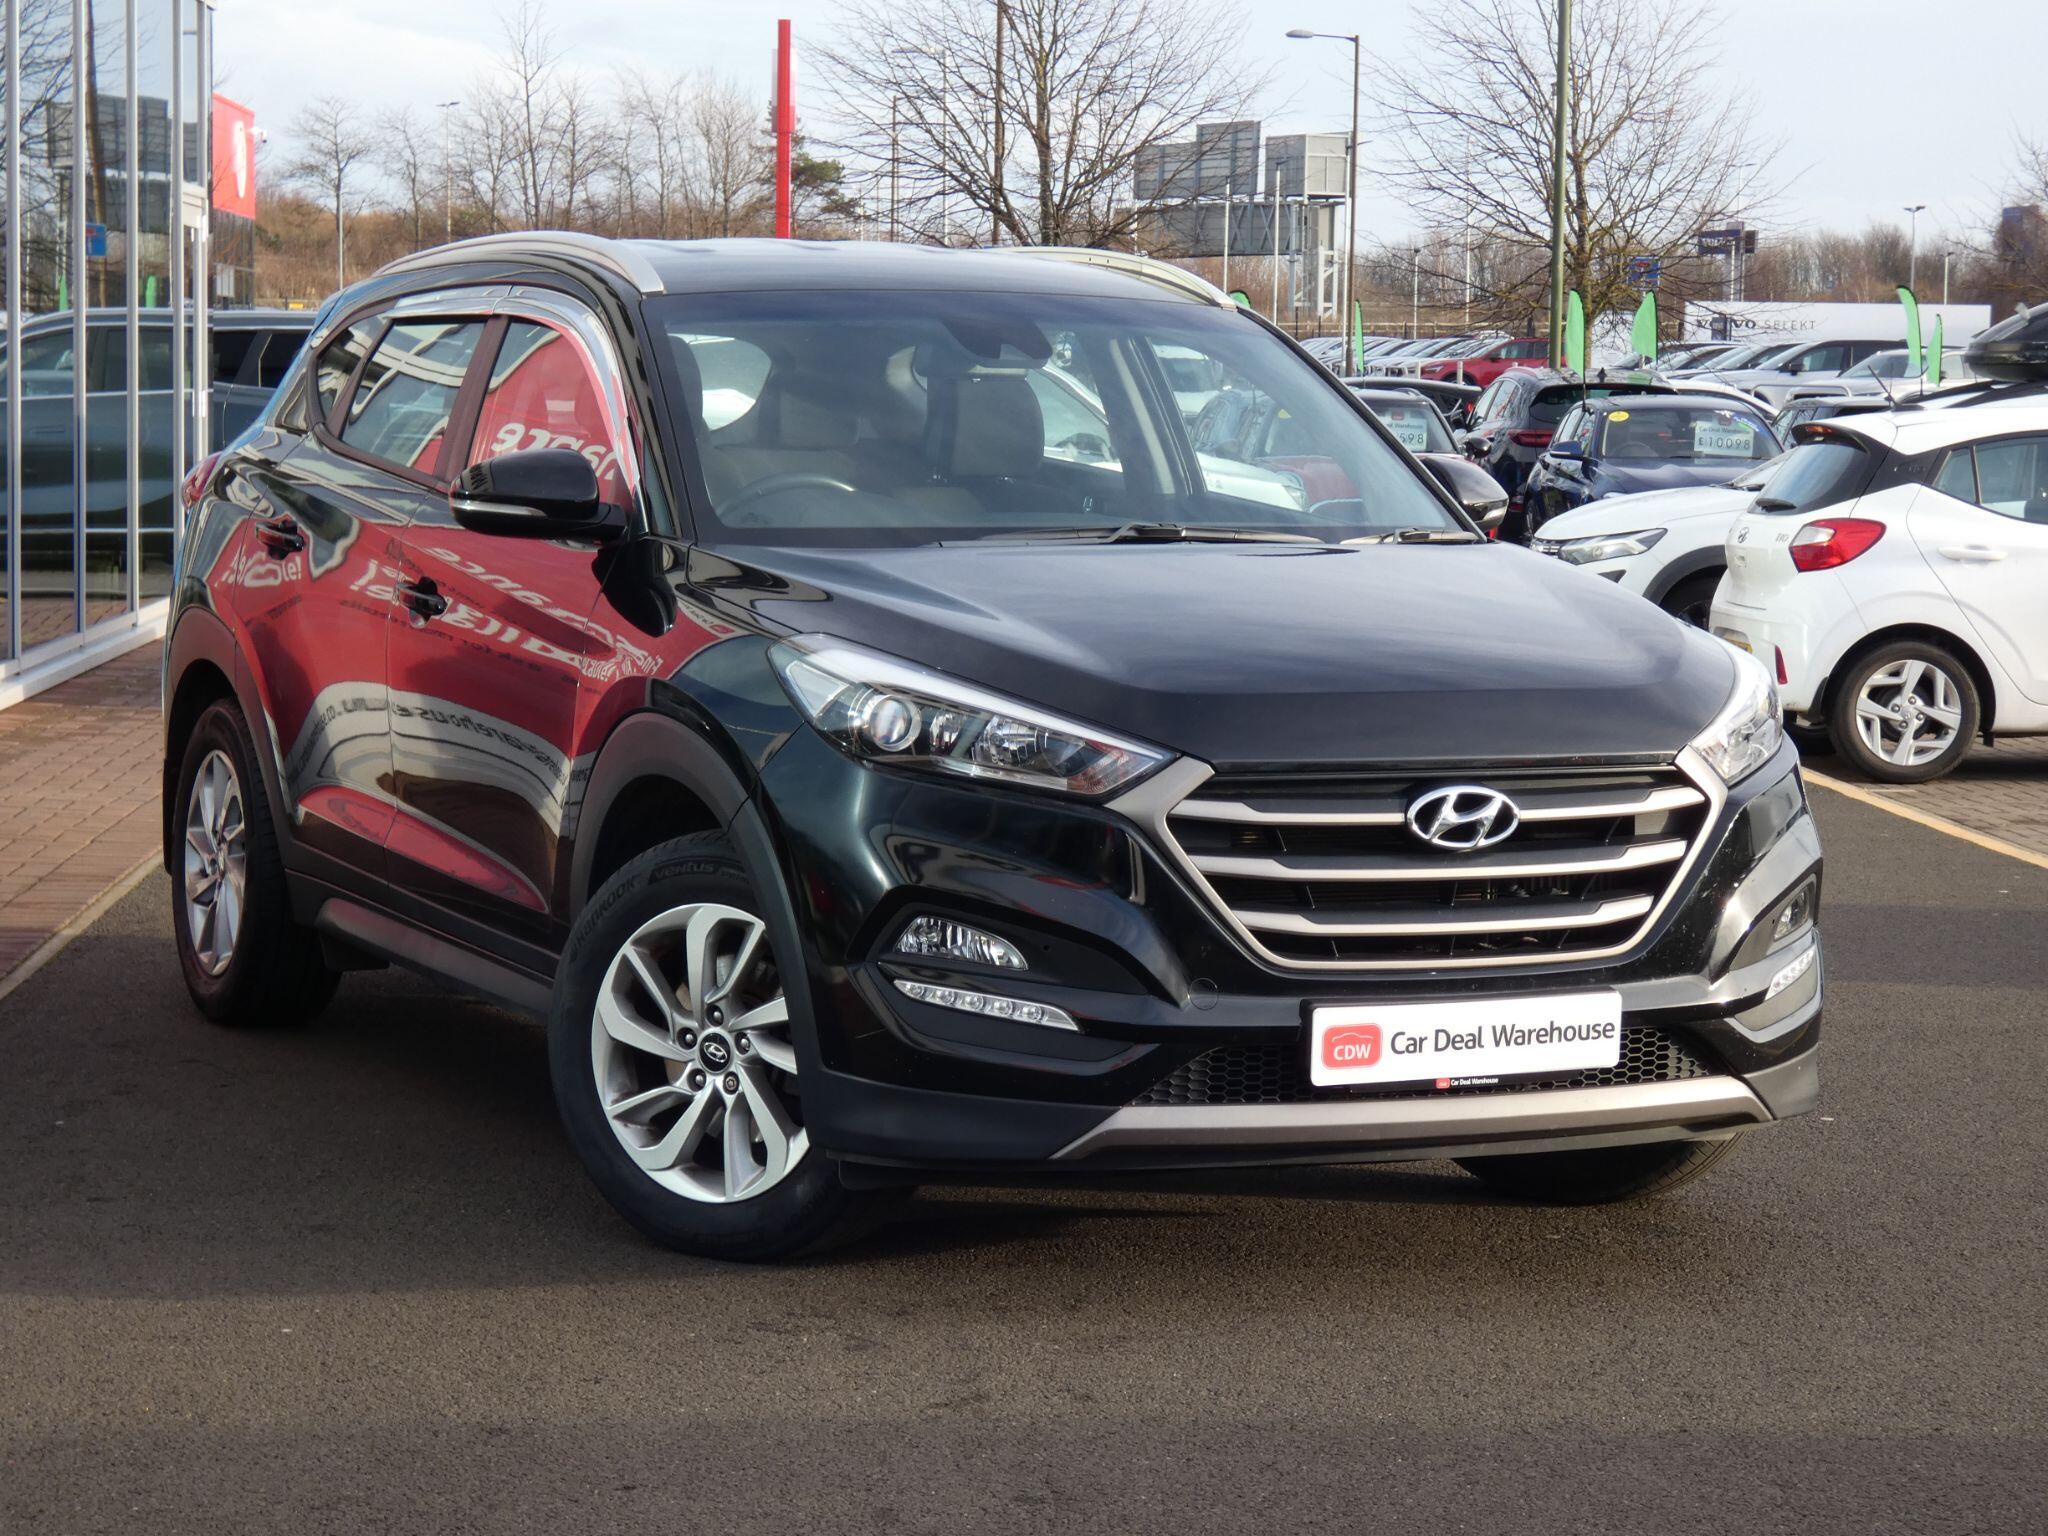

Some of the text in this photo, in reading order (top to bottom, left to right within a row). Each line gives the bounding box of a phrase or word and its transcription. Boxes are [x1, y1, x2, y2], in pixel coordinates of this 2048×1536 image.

[1697, 319, 1817, 330] VVO SELEKT
[1399, 432, 1424, 444] 598
[1698, 436, 1750, 450] £10098
[1390, 1020, 1616, 1055] Car Deal Warehouse
[1333, 1043, 1371, 1061] CDW
[1472, 1077, 1499, 1085] Warehouse
